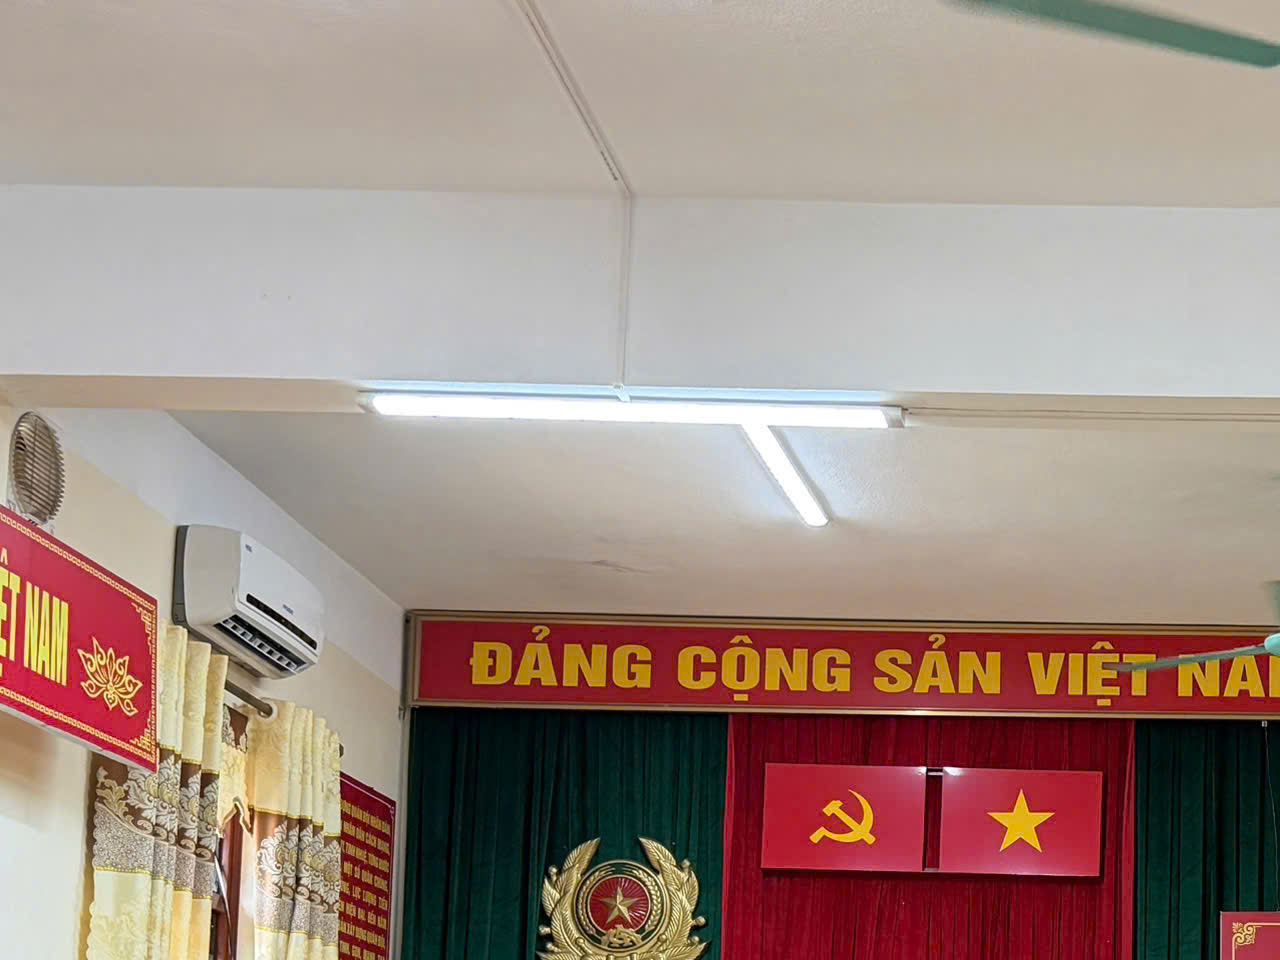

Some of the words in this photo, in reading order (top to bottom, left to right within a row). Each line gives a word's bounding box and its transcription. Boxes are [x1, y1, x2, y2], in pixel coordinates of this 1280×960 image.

[24, 581, 69, 686] NAM
[469, 625, 652, 688] ĐẢNG
[677, 635, 850, 702] CỘNG
[873, 633, 1001, 696] SẢN
[1027, 641, 1157, 706] VIỆT
